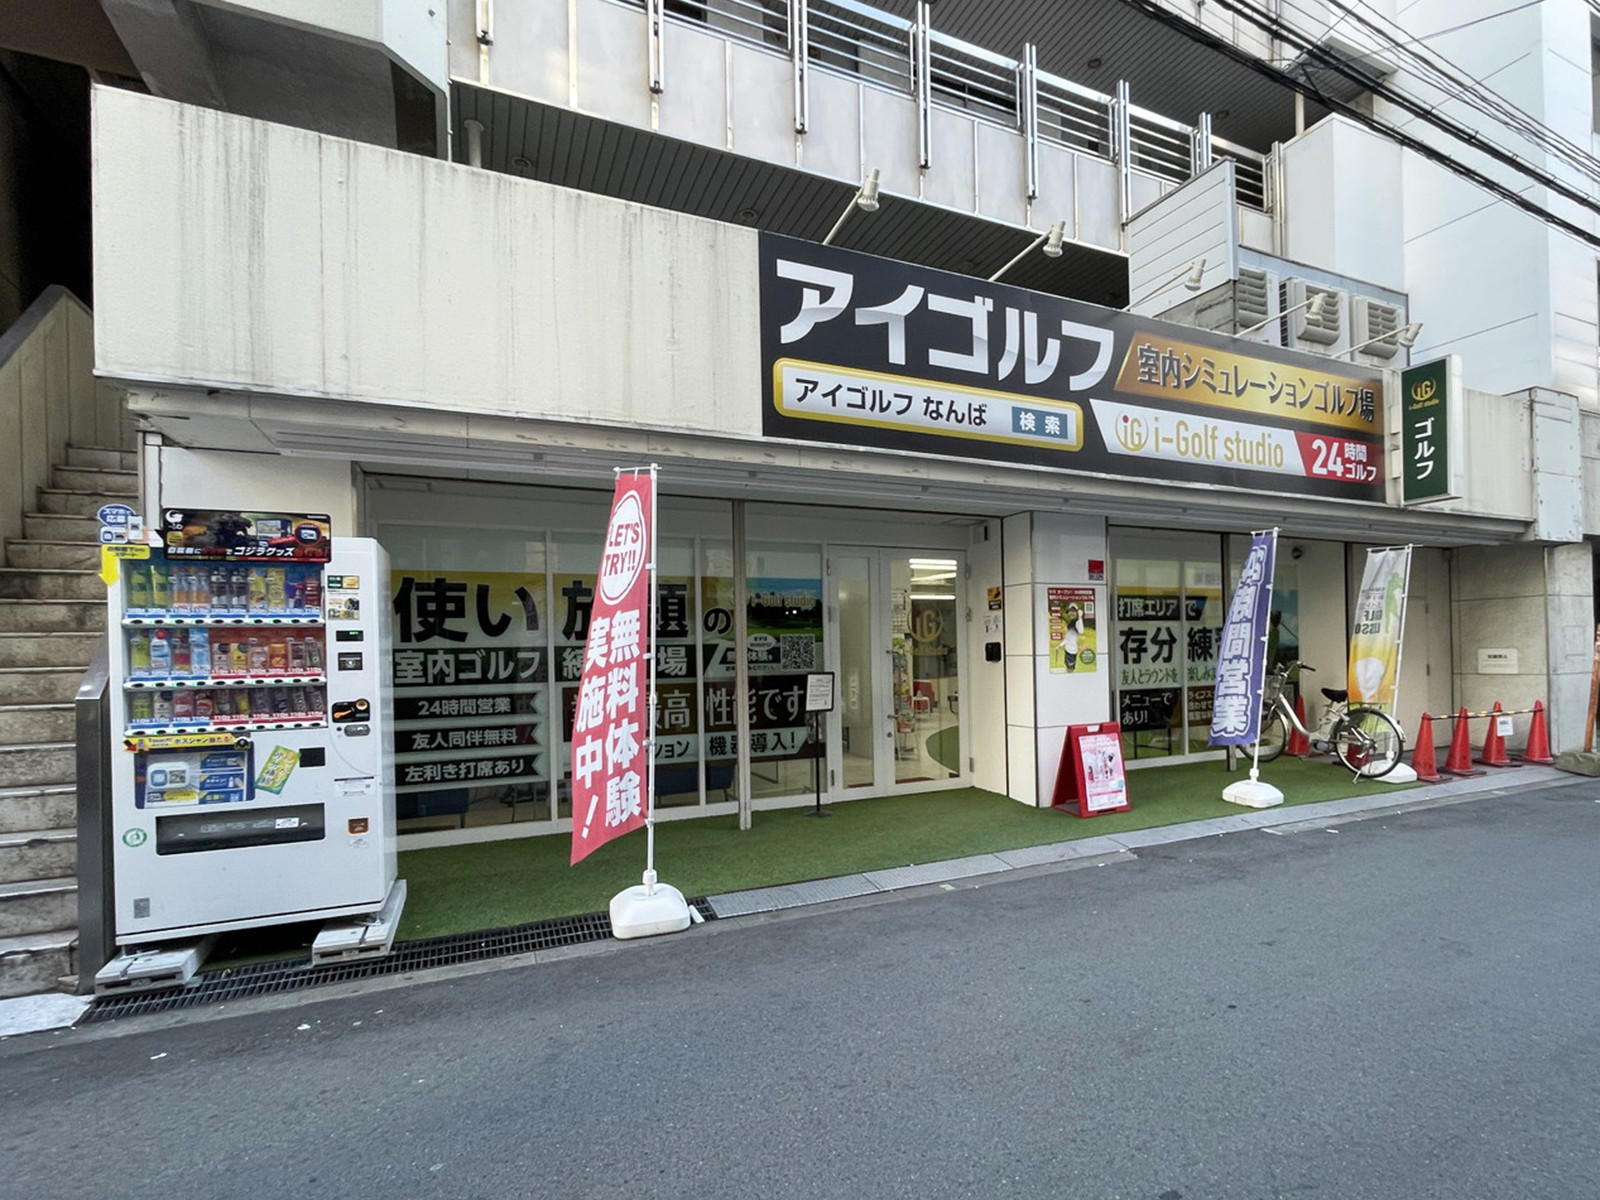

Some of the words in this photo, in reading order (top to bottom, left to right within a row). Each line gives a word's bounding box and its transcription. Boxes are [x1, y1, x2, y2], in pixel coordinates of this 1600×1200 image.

[776, 258, 1114, 392] アイゴルフ
[1136, 342, 1375, 423] 室内シミュレーションゴルフ場
[795, 377, 914, 415] アイゴルフ
[922, 396, 988, 427] なんば
[1019, 411, 1061, 435] 検索
[1154, 417, 1218, 458] i-Golf
[1224, 427, 1285, 469] studio
[1312, 439, 1344, 476] 24
[1344, 443, 1367, 463] 時間
[1414, 417, 1435, 480] ゴルフ
[1345, 462, 1378, 482] ゴルフ
[608, 522, 640, 548] LET'S
[603, 550, 636, 577] TRY!!
[418, 697, 511, 715] 24時間営業
[575, 616, 610, 839] 実施中!
[605, 609, 641, 828] 無料体験
[412, 728, 517, 749] 友人同伴無料
[405, 759, 525, 782] 左利き打席あり
